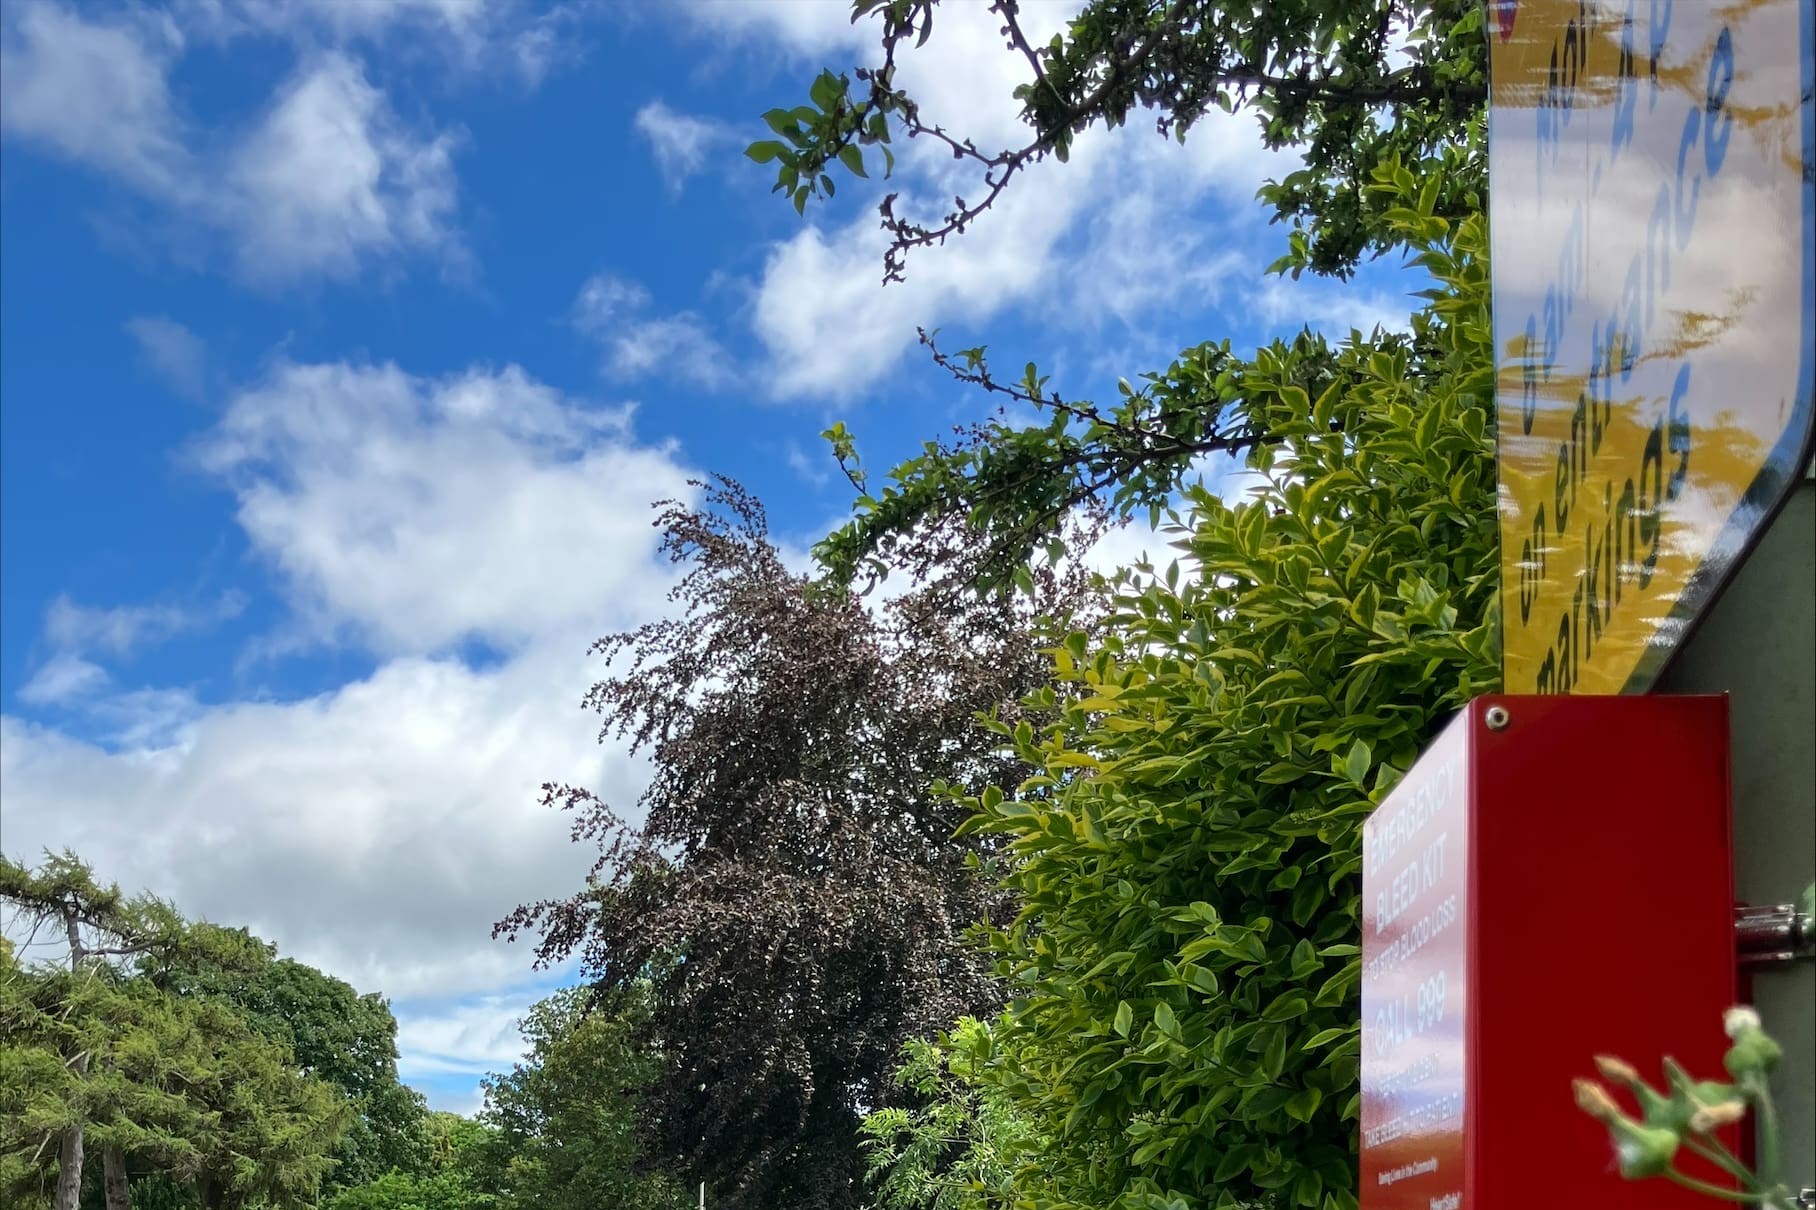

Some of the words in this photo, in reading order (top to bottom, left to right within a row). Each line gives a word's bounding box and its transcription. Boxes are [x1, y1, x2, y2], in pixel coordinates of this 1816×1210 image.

[1521, 501, 1546, 627] on
[1555, 24, 1735, 539] entrance
[1522, 312, 1537, 436] 8
[1543, 199, 1584, 383] am
[1536, 361, 1692, 695] markings
[1370, 757, 1454, 878] EMERGENCY
[1377, 860, 1418, 935] BLEED
[1423, 832, 1447, 890] KIT
[1400, 914, 1430, 961] BLOOD
[1431, 894, 1456, 939] LOSS
[1375, 989, 1412, 1057] CALL
[1416, 967, 1445, 1034] 999
